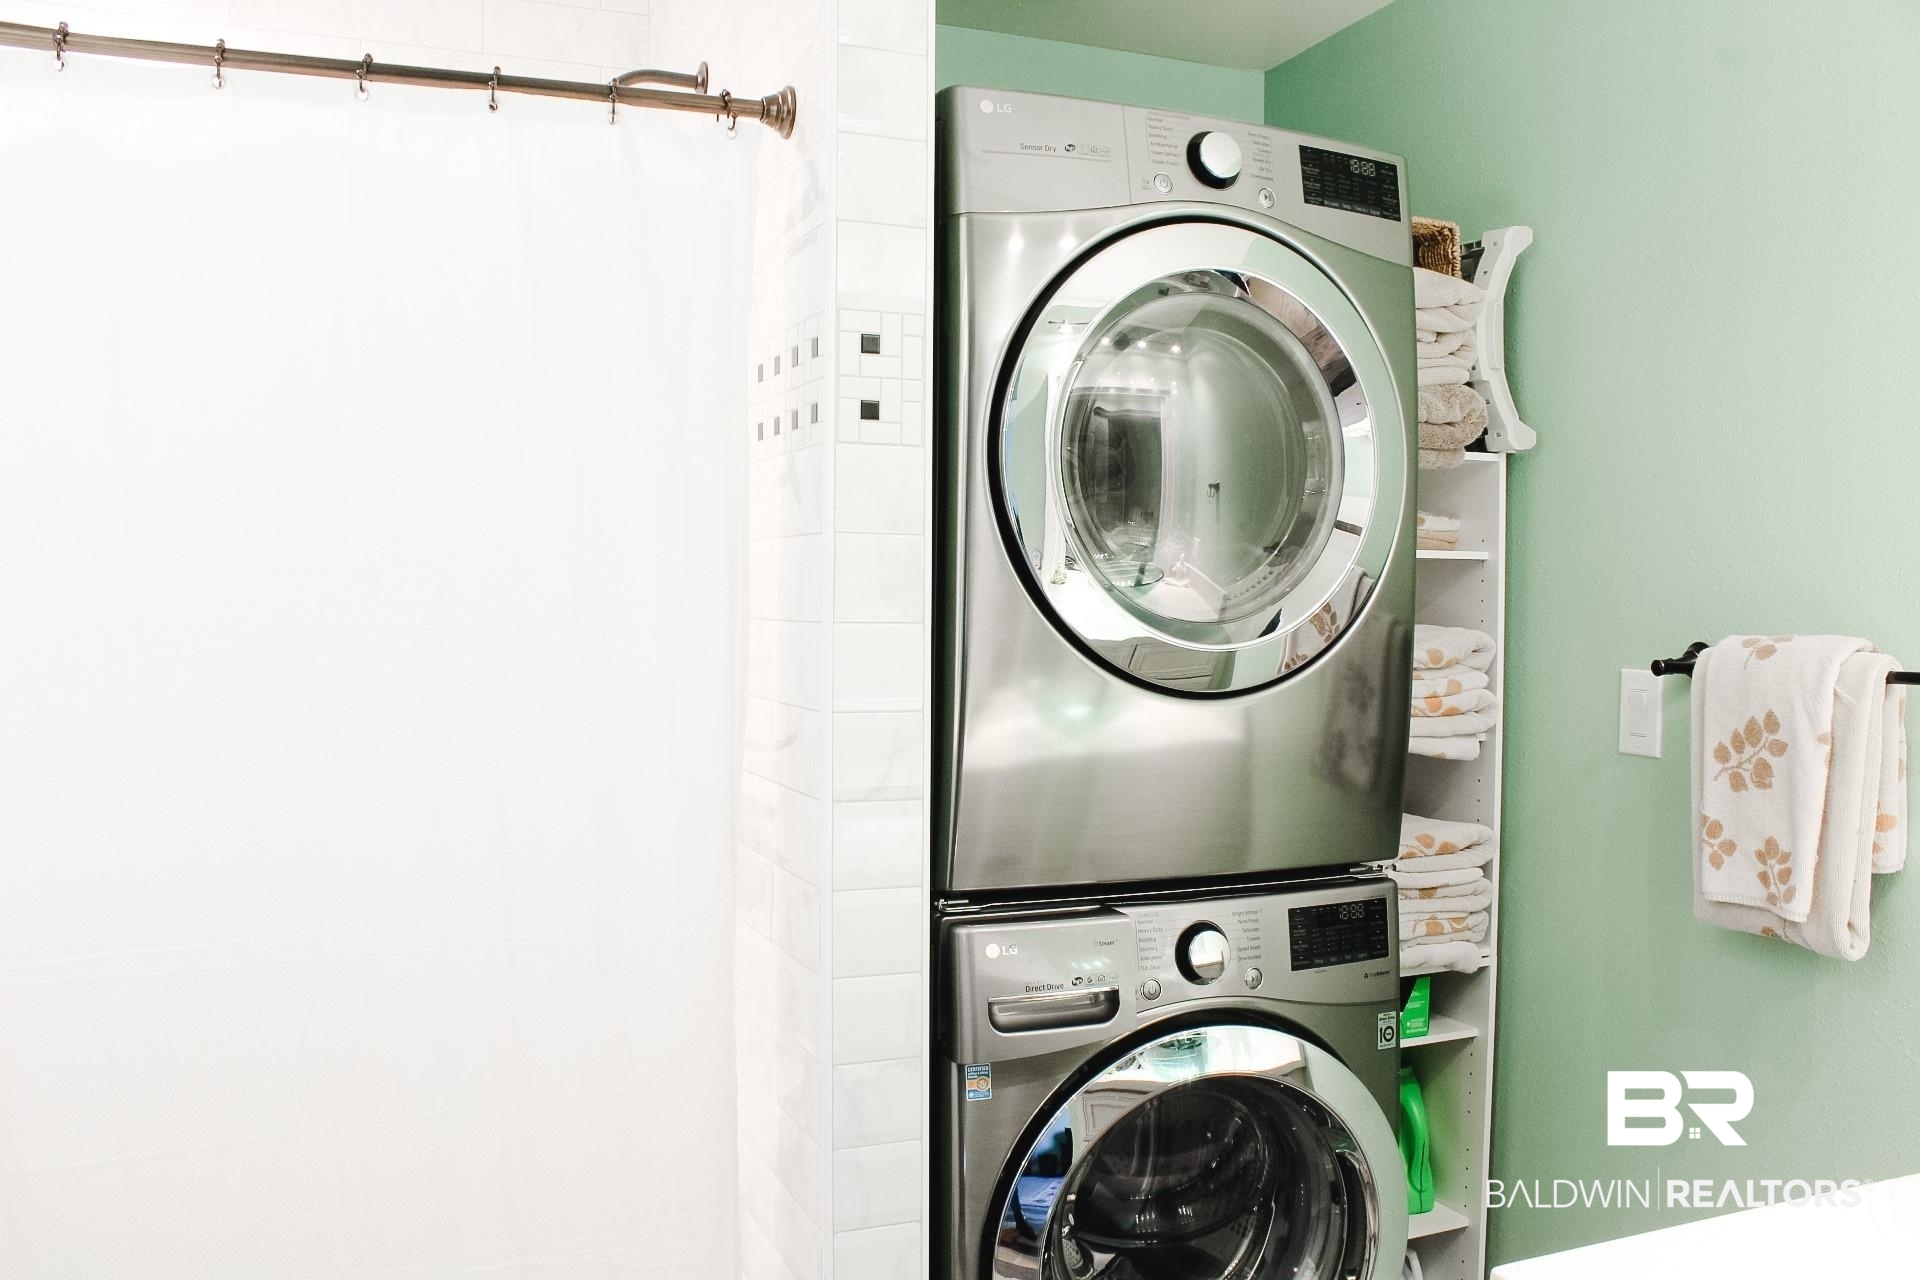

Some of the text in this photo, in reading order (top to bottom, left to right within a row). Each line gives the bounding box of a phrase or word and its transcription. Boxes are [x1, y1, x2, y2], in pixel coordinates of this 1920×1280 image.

[997, 103, 1012, 113] LG
[1019, 142, 1057, 153] Sensor Dry
[1002, 944, 1018, 956] LG
[1025, 984, 1046, 992] Direct
[1046, 982, 1064, 991] Drive
